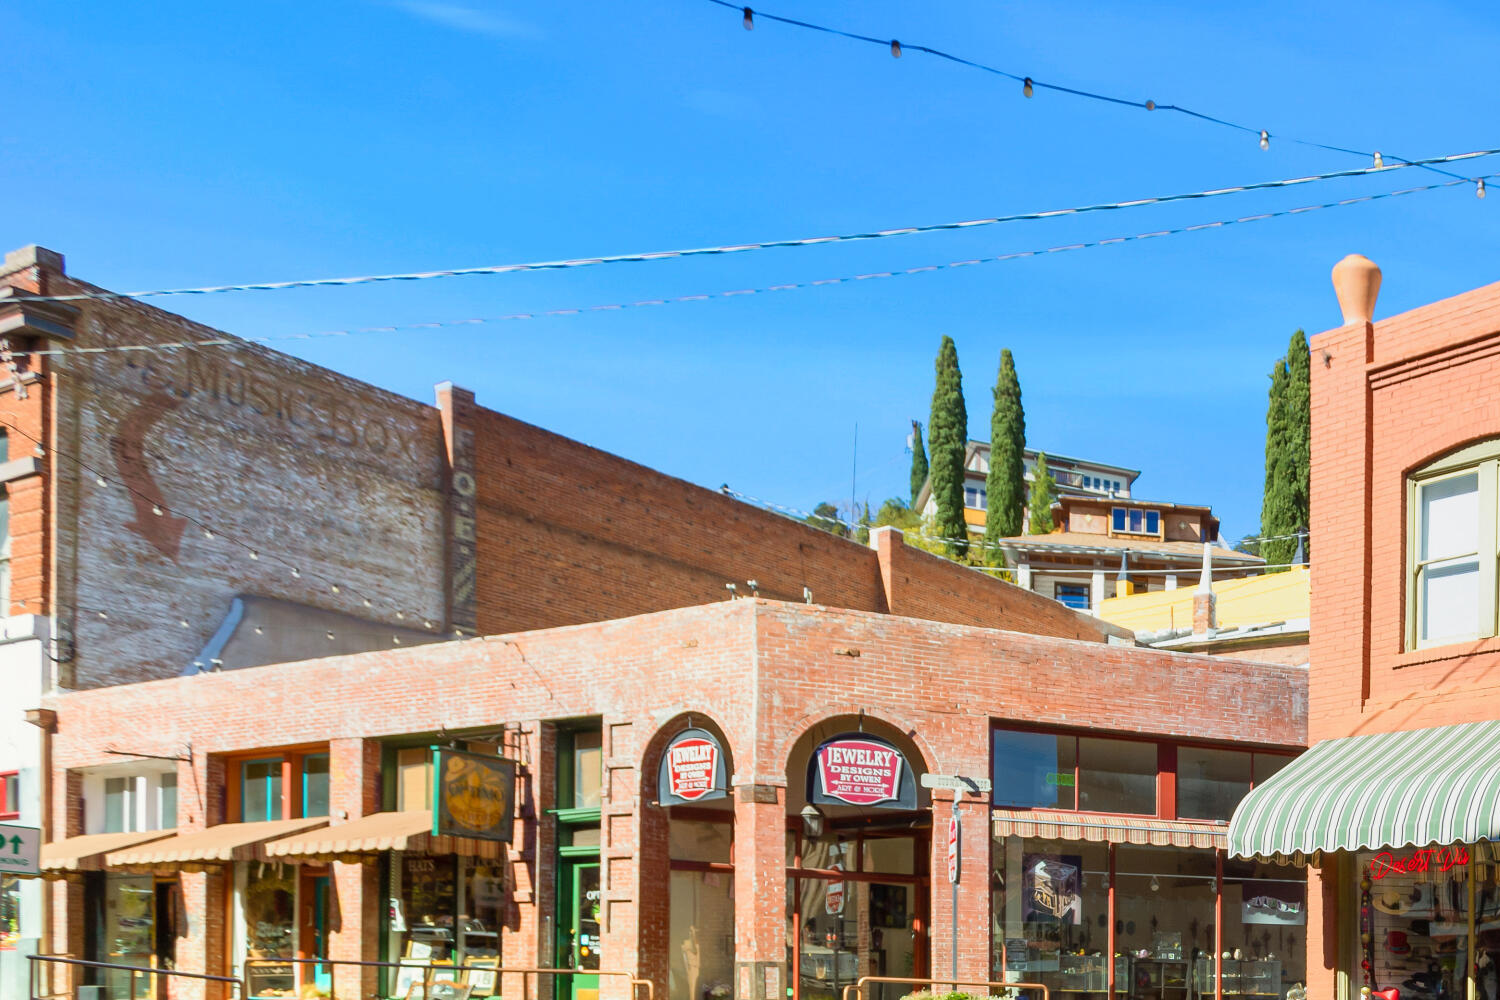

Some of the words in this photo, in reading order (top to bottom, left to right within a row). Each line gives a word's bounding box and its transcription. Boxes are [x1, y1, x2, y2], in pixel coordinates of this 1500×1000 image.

[672, 745, 712, 767] JEWELRY
[827, 746, 893, 767] JEWELRY
[675, 762, 711, 772] DESIGNS
[830, 765, 892, 777] DESIGNS
[840, 773, 851, 781] BY
[853, 774, 882, 784] OWEN
[863, 786, 885, 794] MORE
[408, 860, 435, 872] HATS
[1370, 849, 1436, 880] Desert
